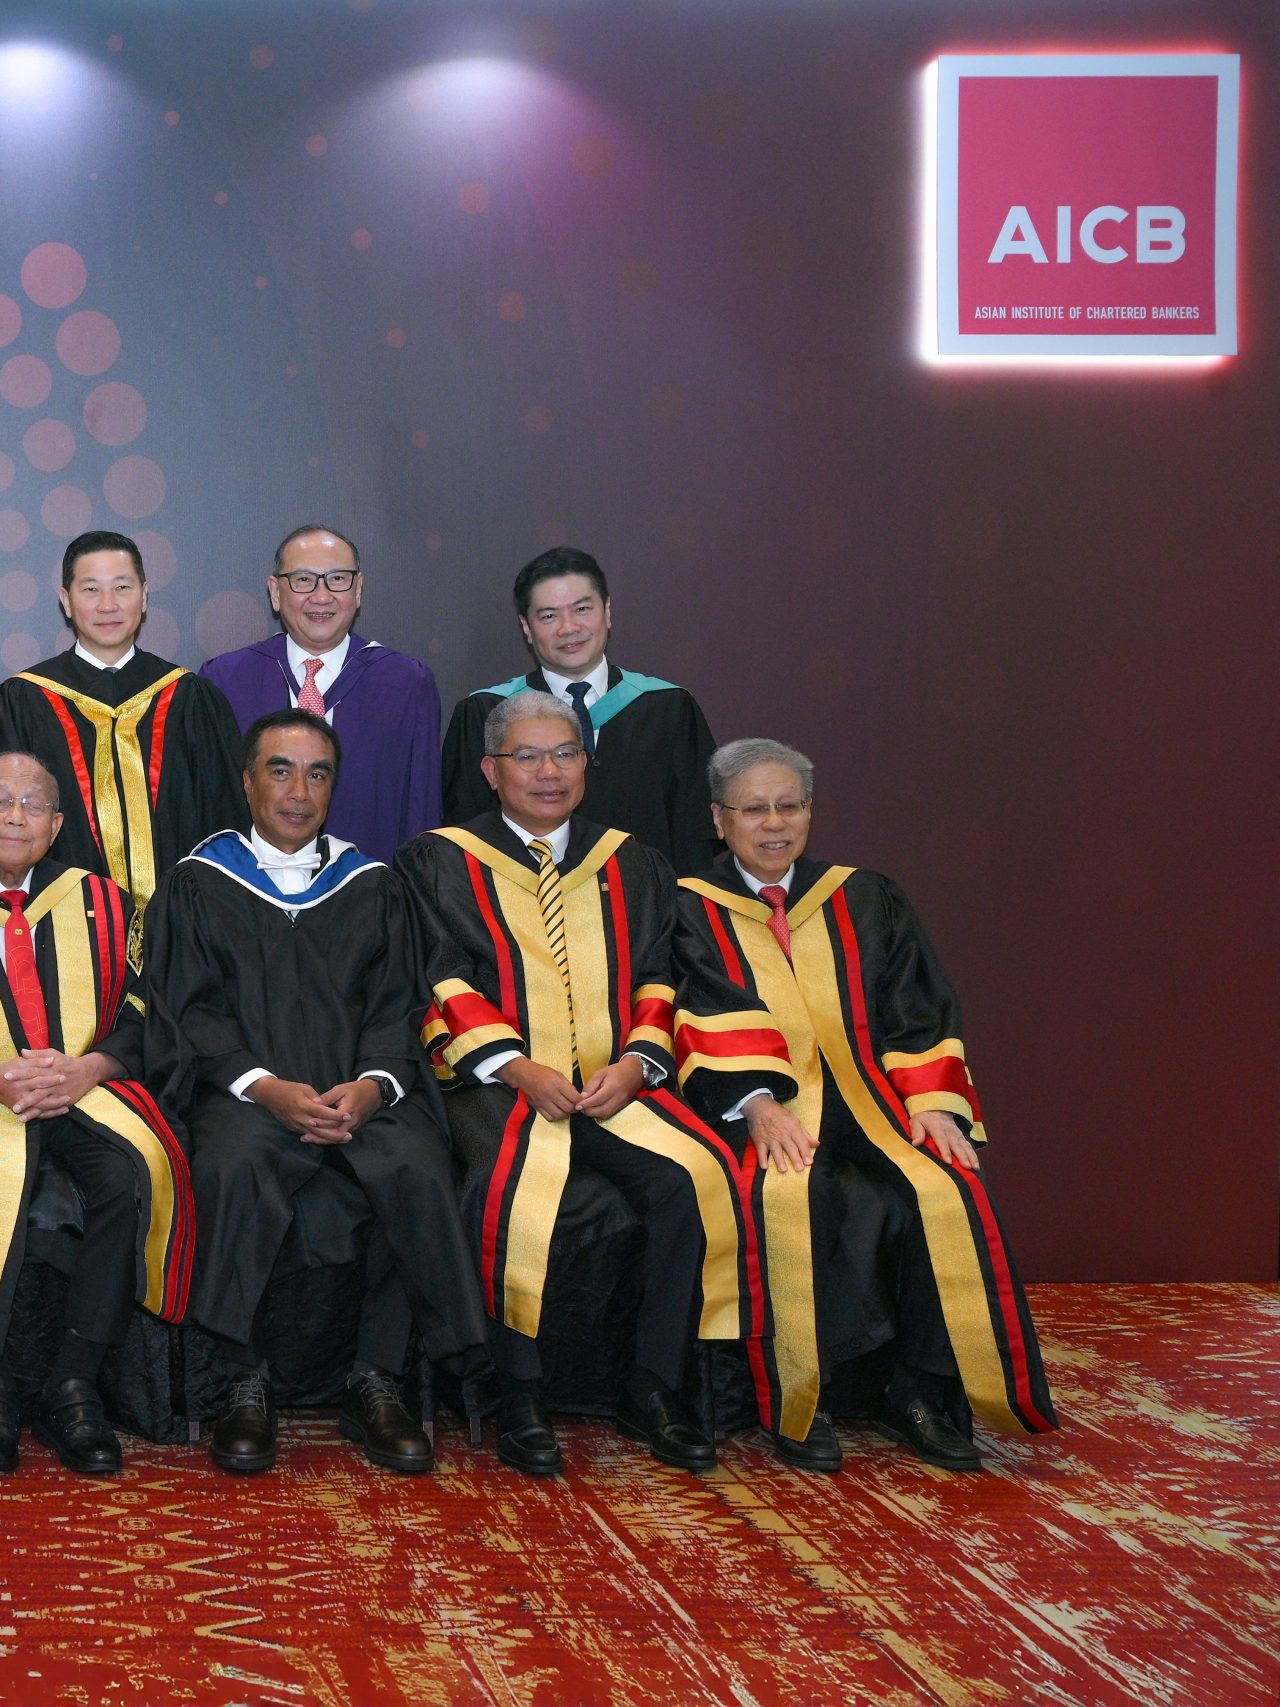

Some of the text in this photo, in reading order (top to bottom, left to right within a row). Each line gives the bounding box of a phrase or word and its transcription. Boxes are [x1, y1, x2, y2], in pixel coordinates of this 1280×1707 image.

[987, 205, 1186, 264] AICB
[974, 306, 1200, 319] ASIAN INSTITUTE OF CHARTERED BANKERS
